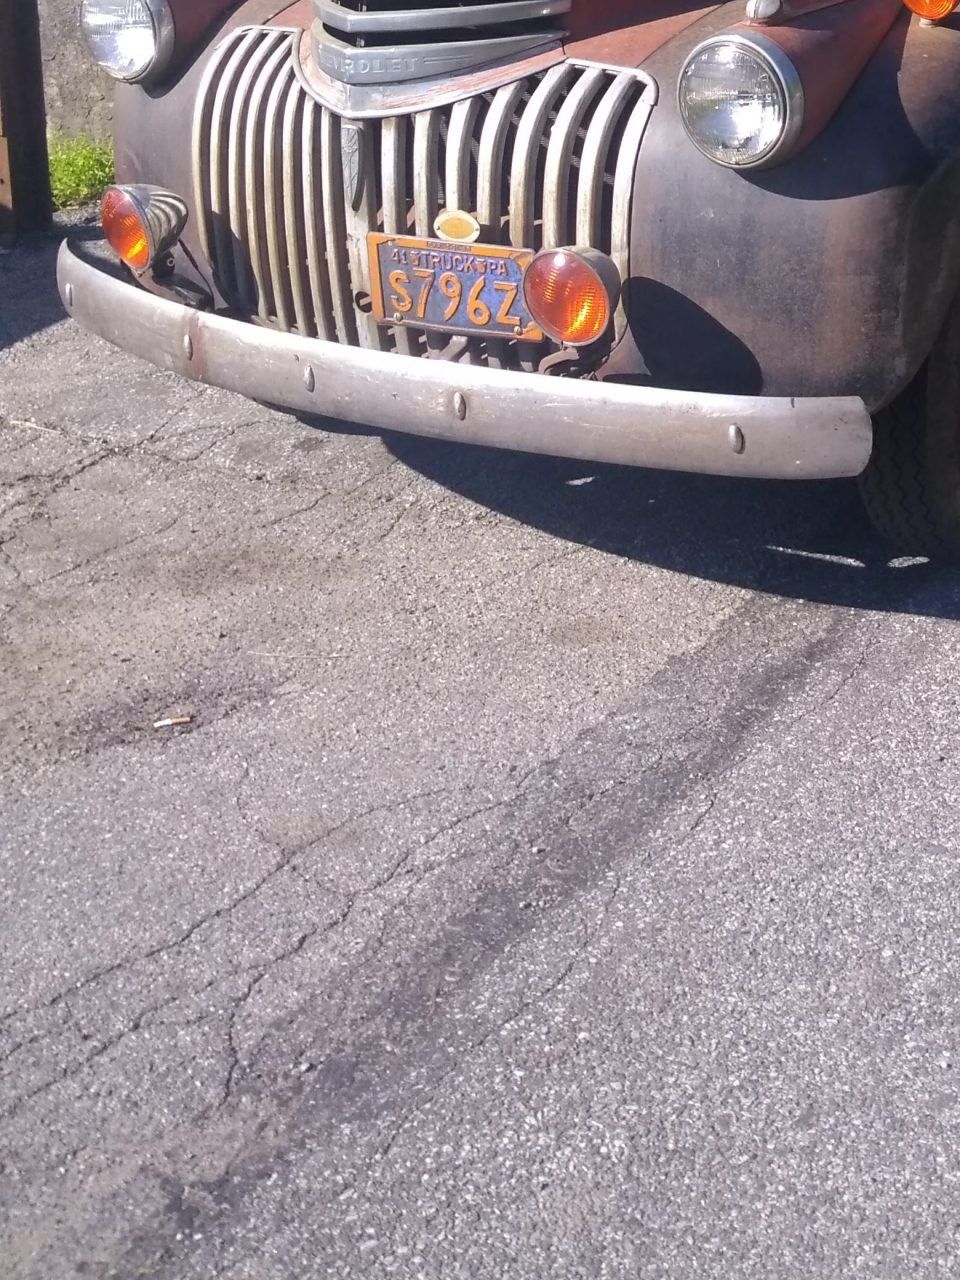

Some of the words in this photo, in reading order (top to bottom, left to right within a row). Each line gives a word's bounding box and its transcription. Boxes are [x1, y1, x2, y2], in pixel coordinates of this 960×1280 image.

[325, 55, 419, 74] VROLET
[391, 248, 408, 265] 41
[420, 250, 476, 273] TRUCK
[488, 260, 508, 276] PA
[389, 268, 521, 326] S796Z
